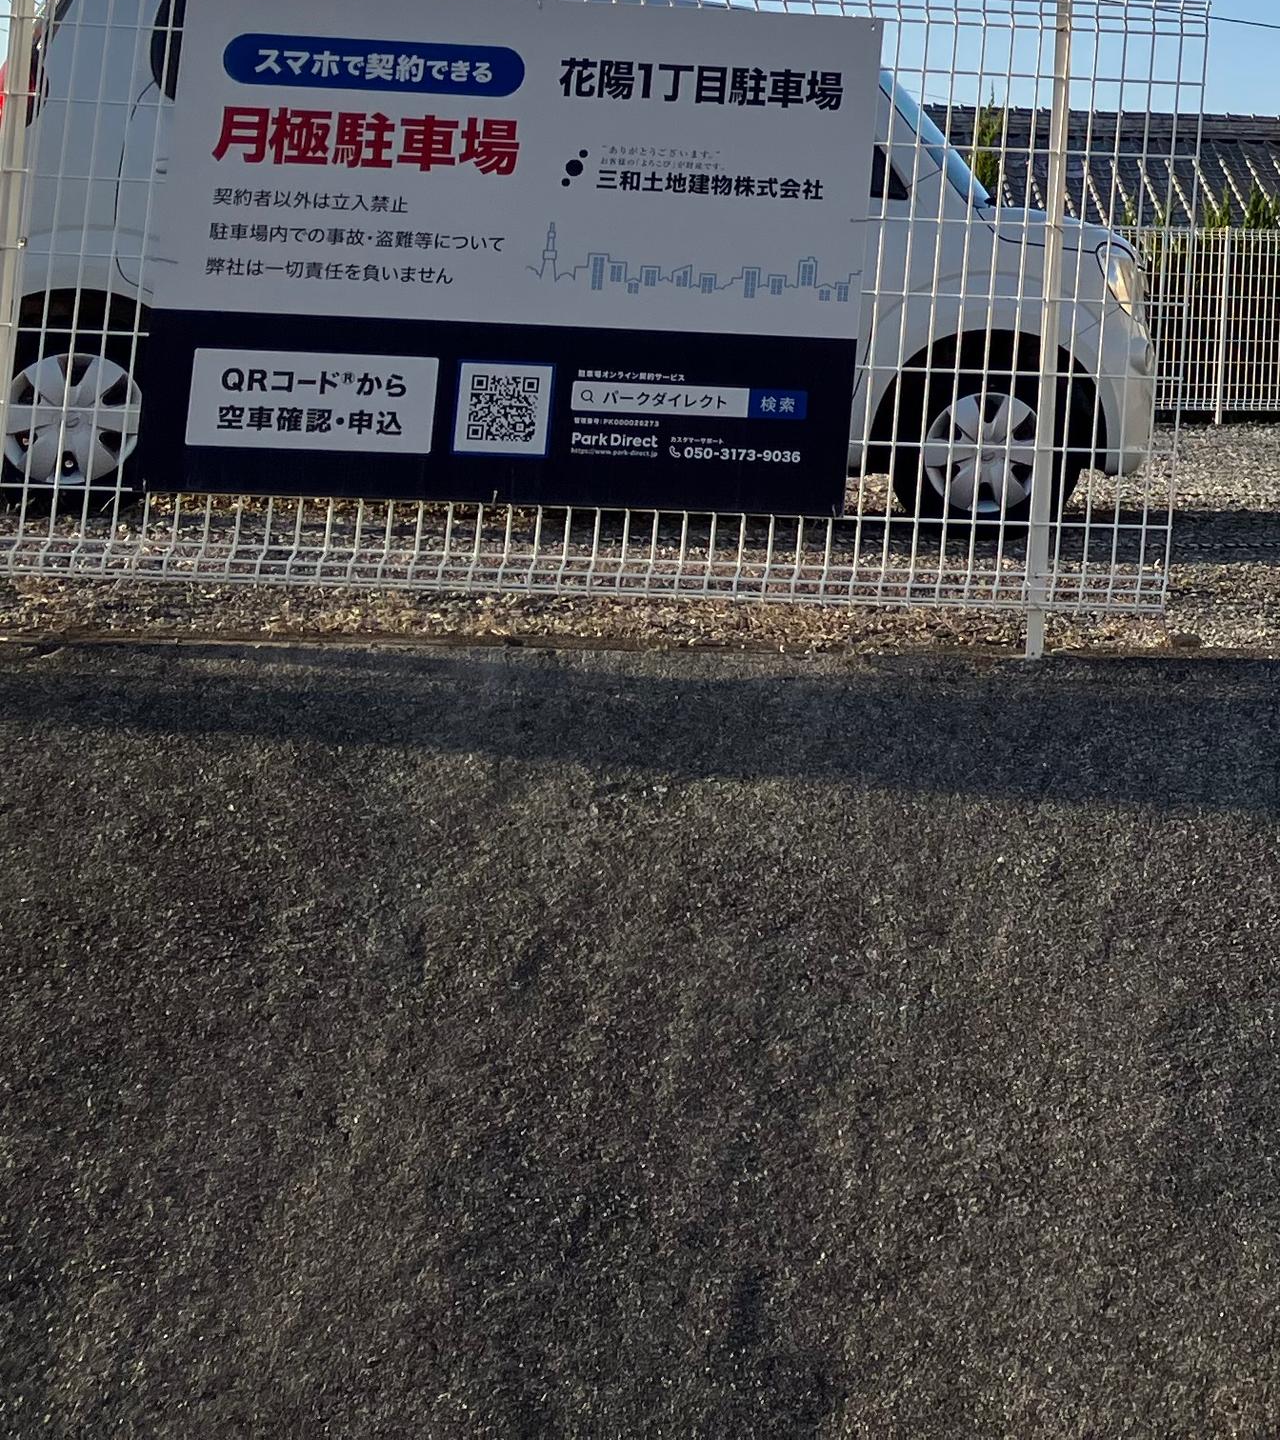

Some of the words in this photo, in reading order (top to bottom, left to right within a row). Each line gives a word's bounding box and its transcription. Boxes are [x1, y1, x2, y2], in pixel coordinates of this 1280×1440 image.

[254, 48, 494, 83] スマホで契約できる
[559, 57, 844, 111] 花陽1丁目駐車場
[211, 105, 520, 175] 月極駐車場
[596, 169, 824, 200] 三和土地建物株式会社
[212, 187, 409, 213] 契約者以外は立入禁止
[209, 222, 506, 252] 駐車場内での事故・盗難等について
[205, 256, 453, 284] 弊社は一切責任を負いません
[602, 389, 727, 409] パークダイレクト
[760, 396, 795, 413] 検索
[216, 405, 402, 436] 空車確認・申込
[571, 431, 608, 446] Park
[610, 433, 658, 448] Direct
[684, 446, 801, 463] 050-3173-9036
